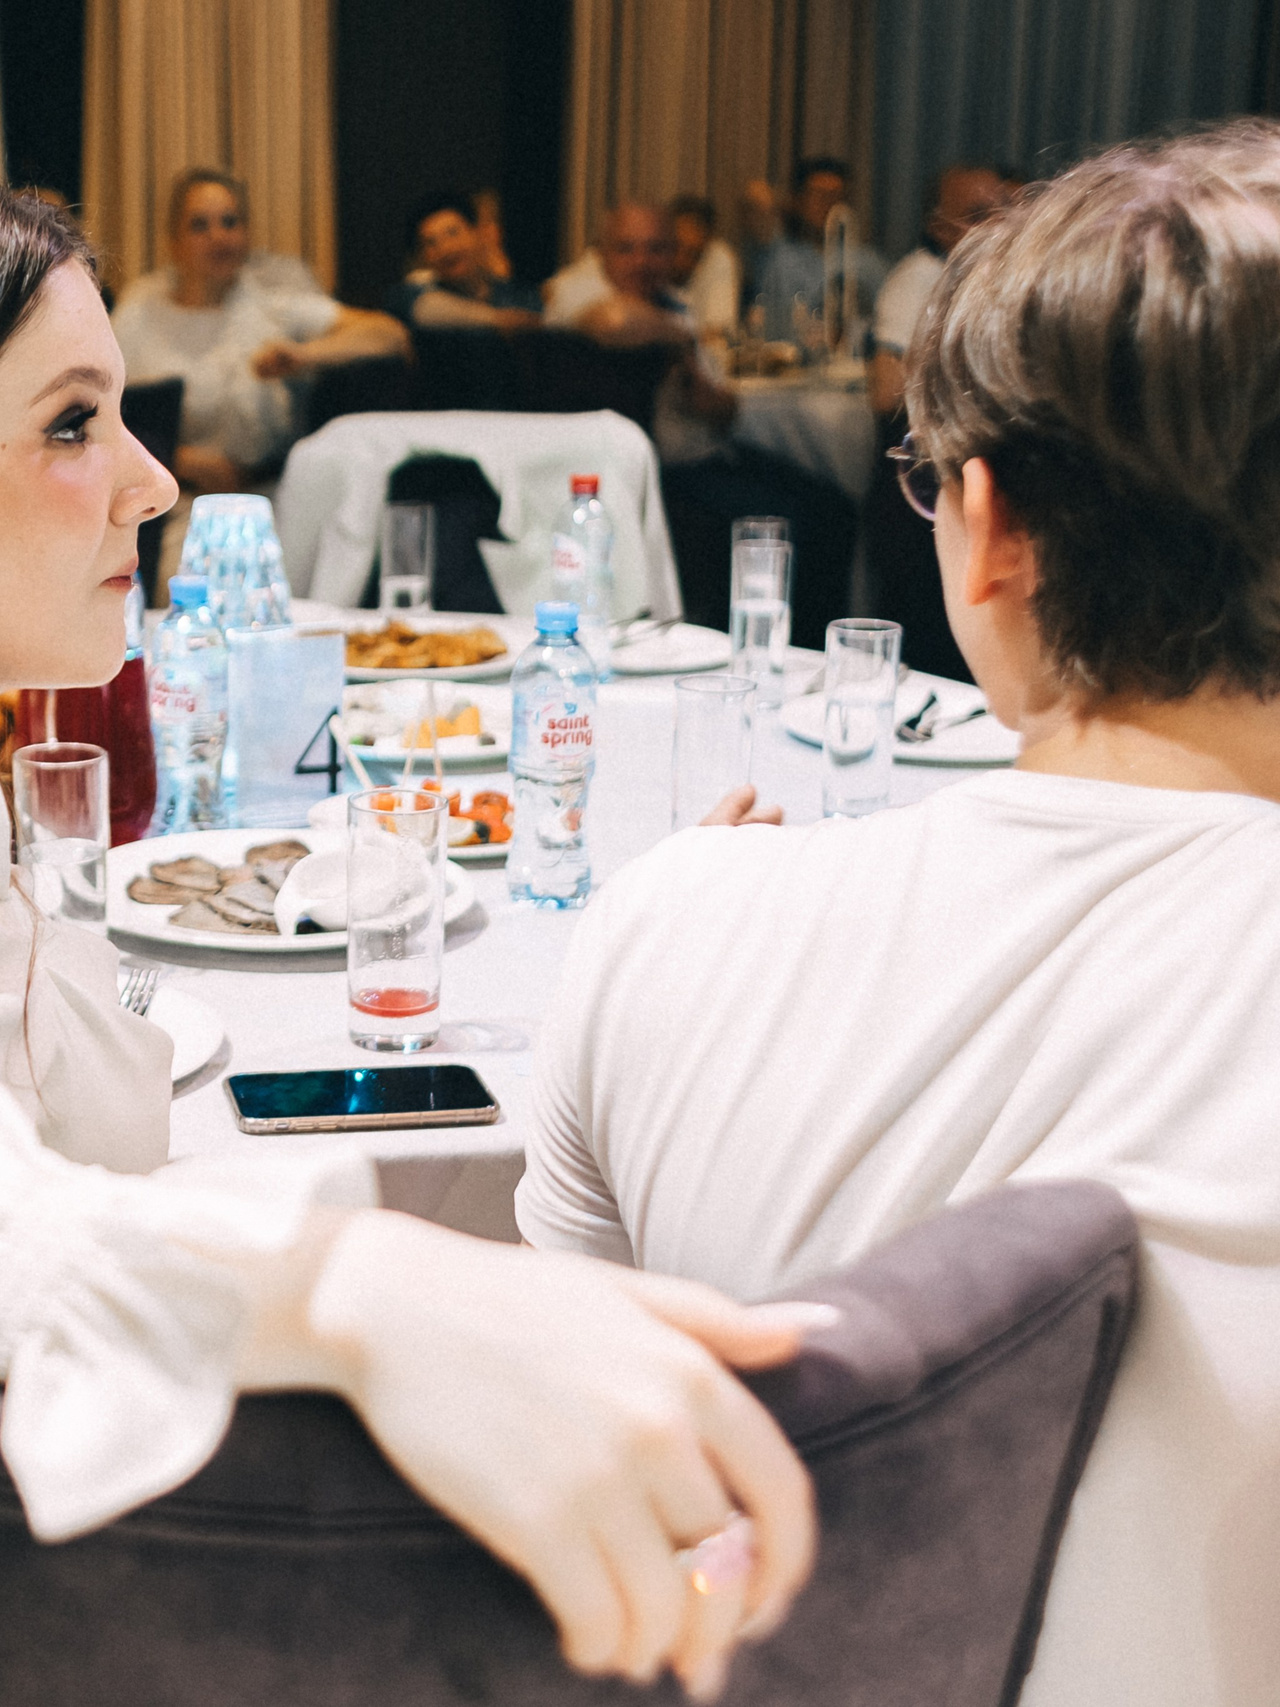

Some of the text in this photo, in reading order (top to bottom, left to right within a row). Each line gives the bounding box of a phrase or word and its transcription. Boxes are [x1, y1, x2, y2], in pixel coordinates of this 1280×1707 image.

[547, 714, 590, 730] saint
[540, 729, 593, 748] spring
[295, 706, 342, 793] 4
